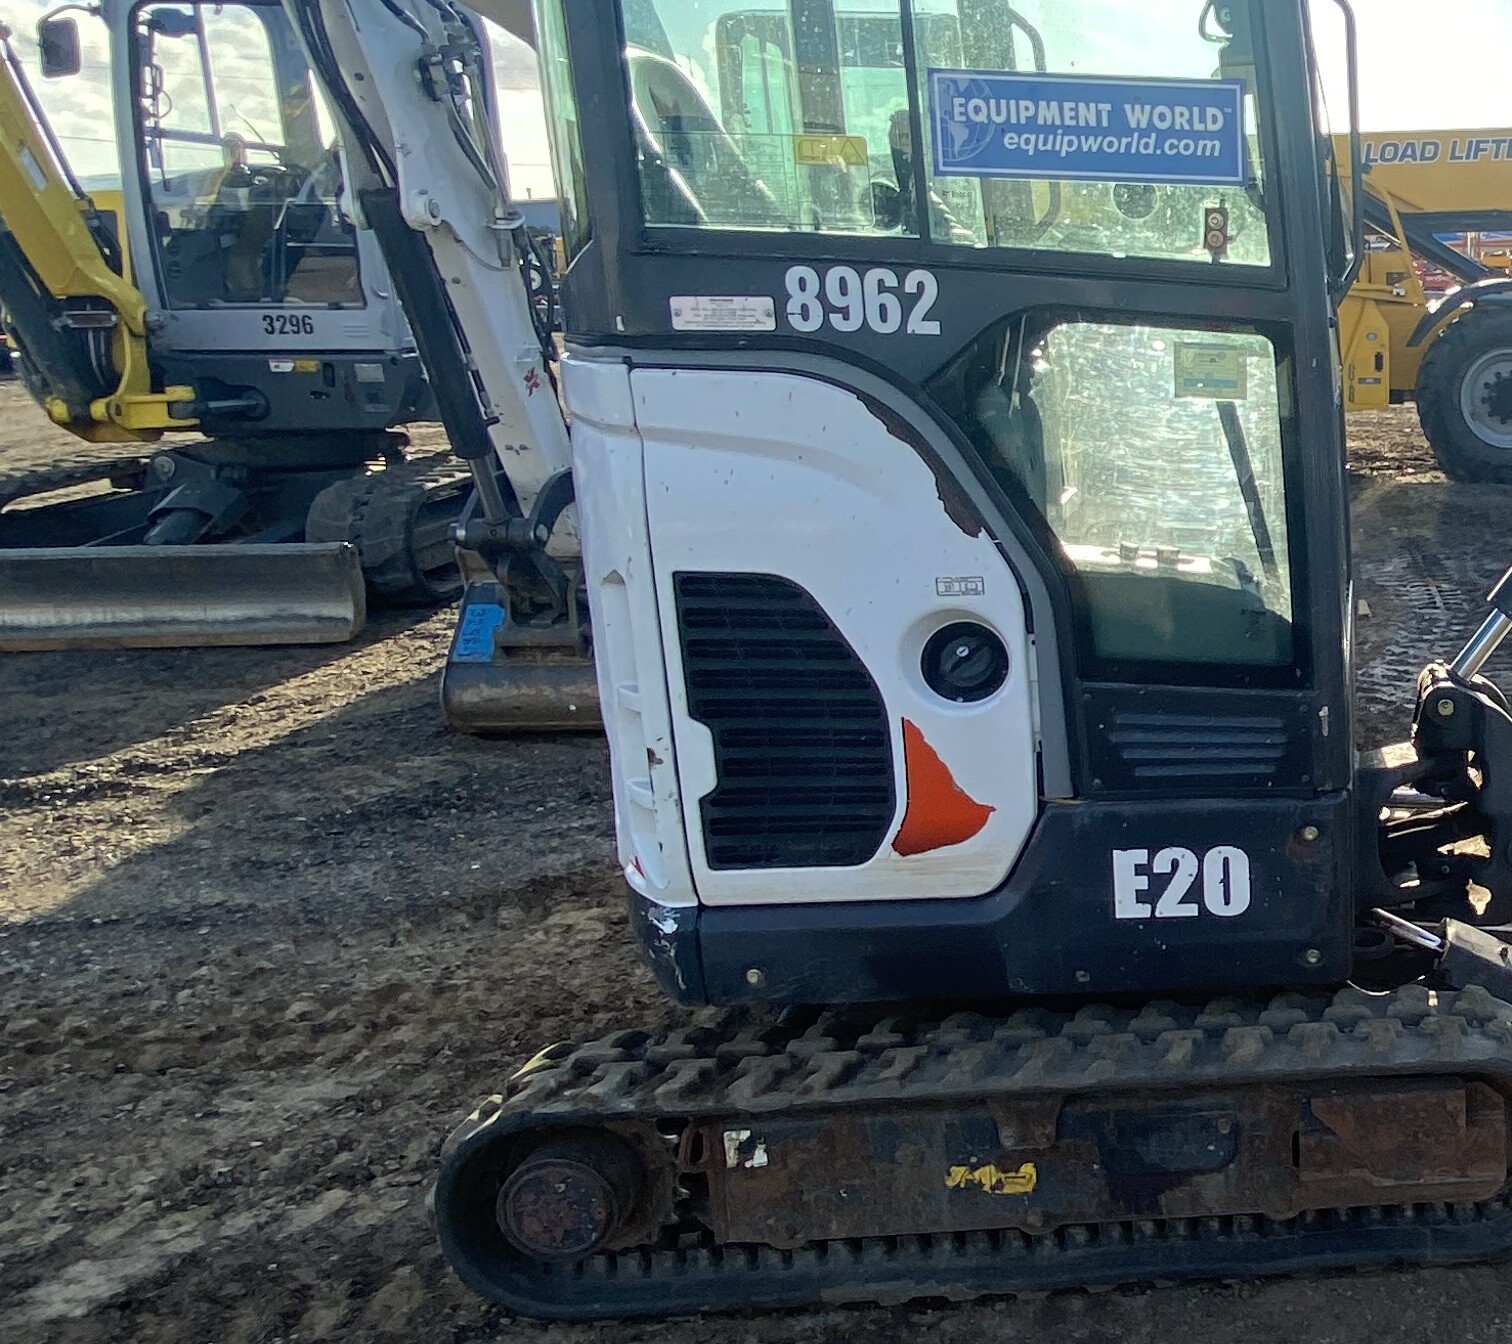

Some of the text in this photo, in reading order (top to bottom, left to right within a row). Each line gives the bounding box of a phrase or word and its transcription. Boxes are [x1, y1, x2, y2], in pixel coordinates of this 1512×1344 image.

[952, 97, 1112, 127] EQUIPMENT
[1003, 129, 1221, 157] equipworld.com
[1363, 139, 1442, 165] LOAD
[785, 265, 941, 335] 8962
[262, 314, 314, 335] 3296
[1112, 845, 1250, 919] E20
